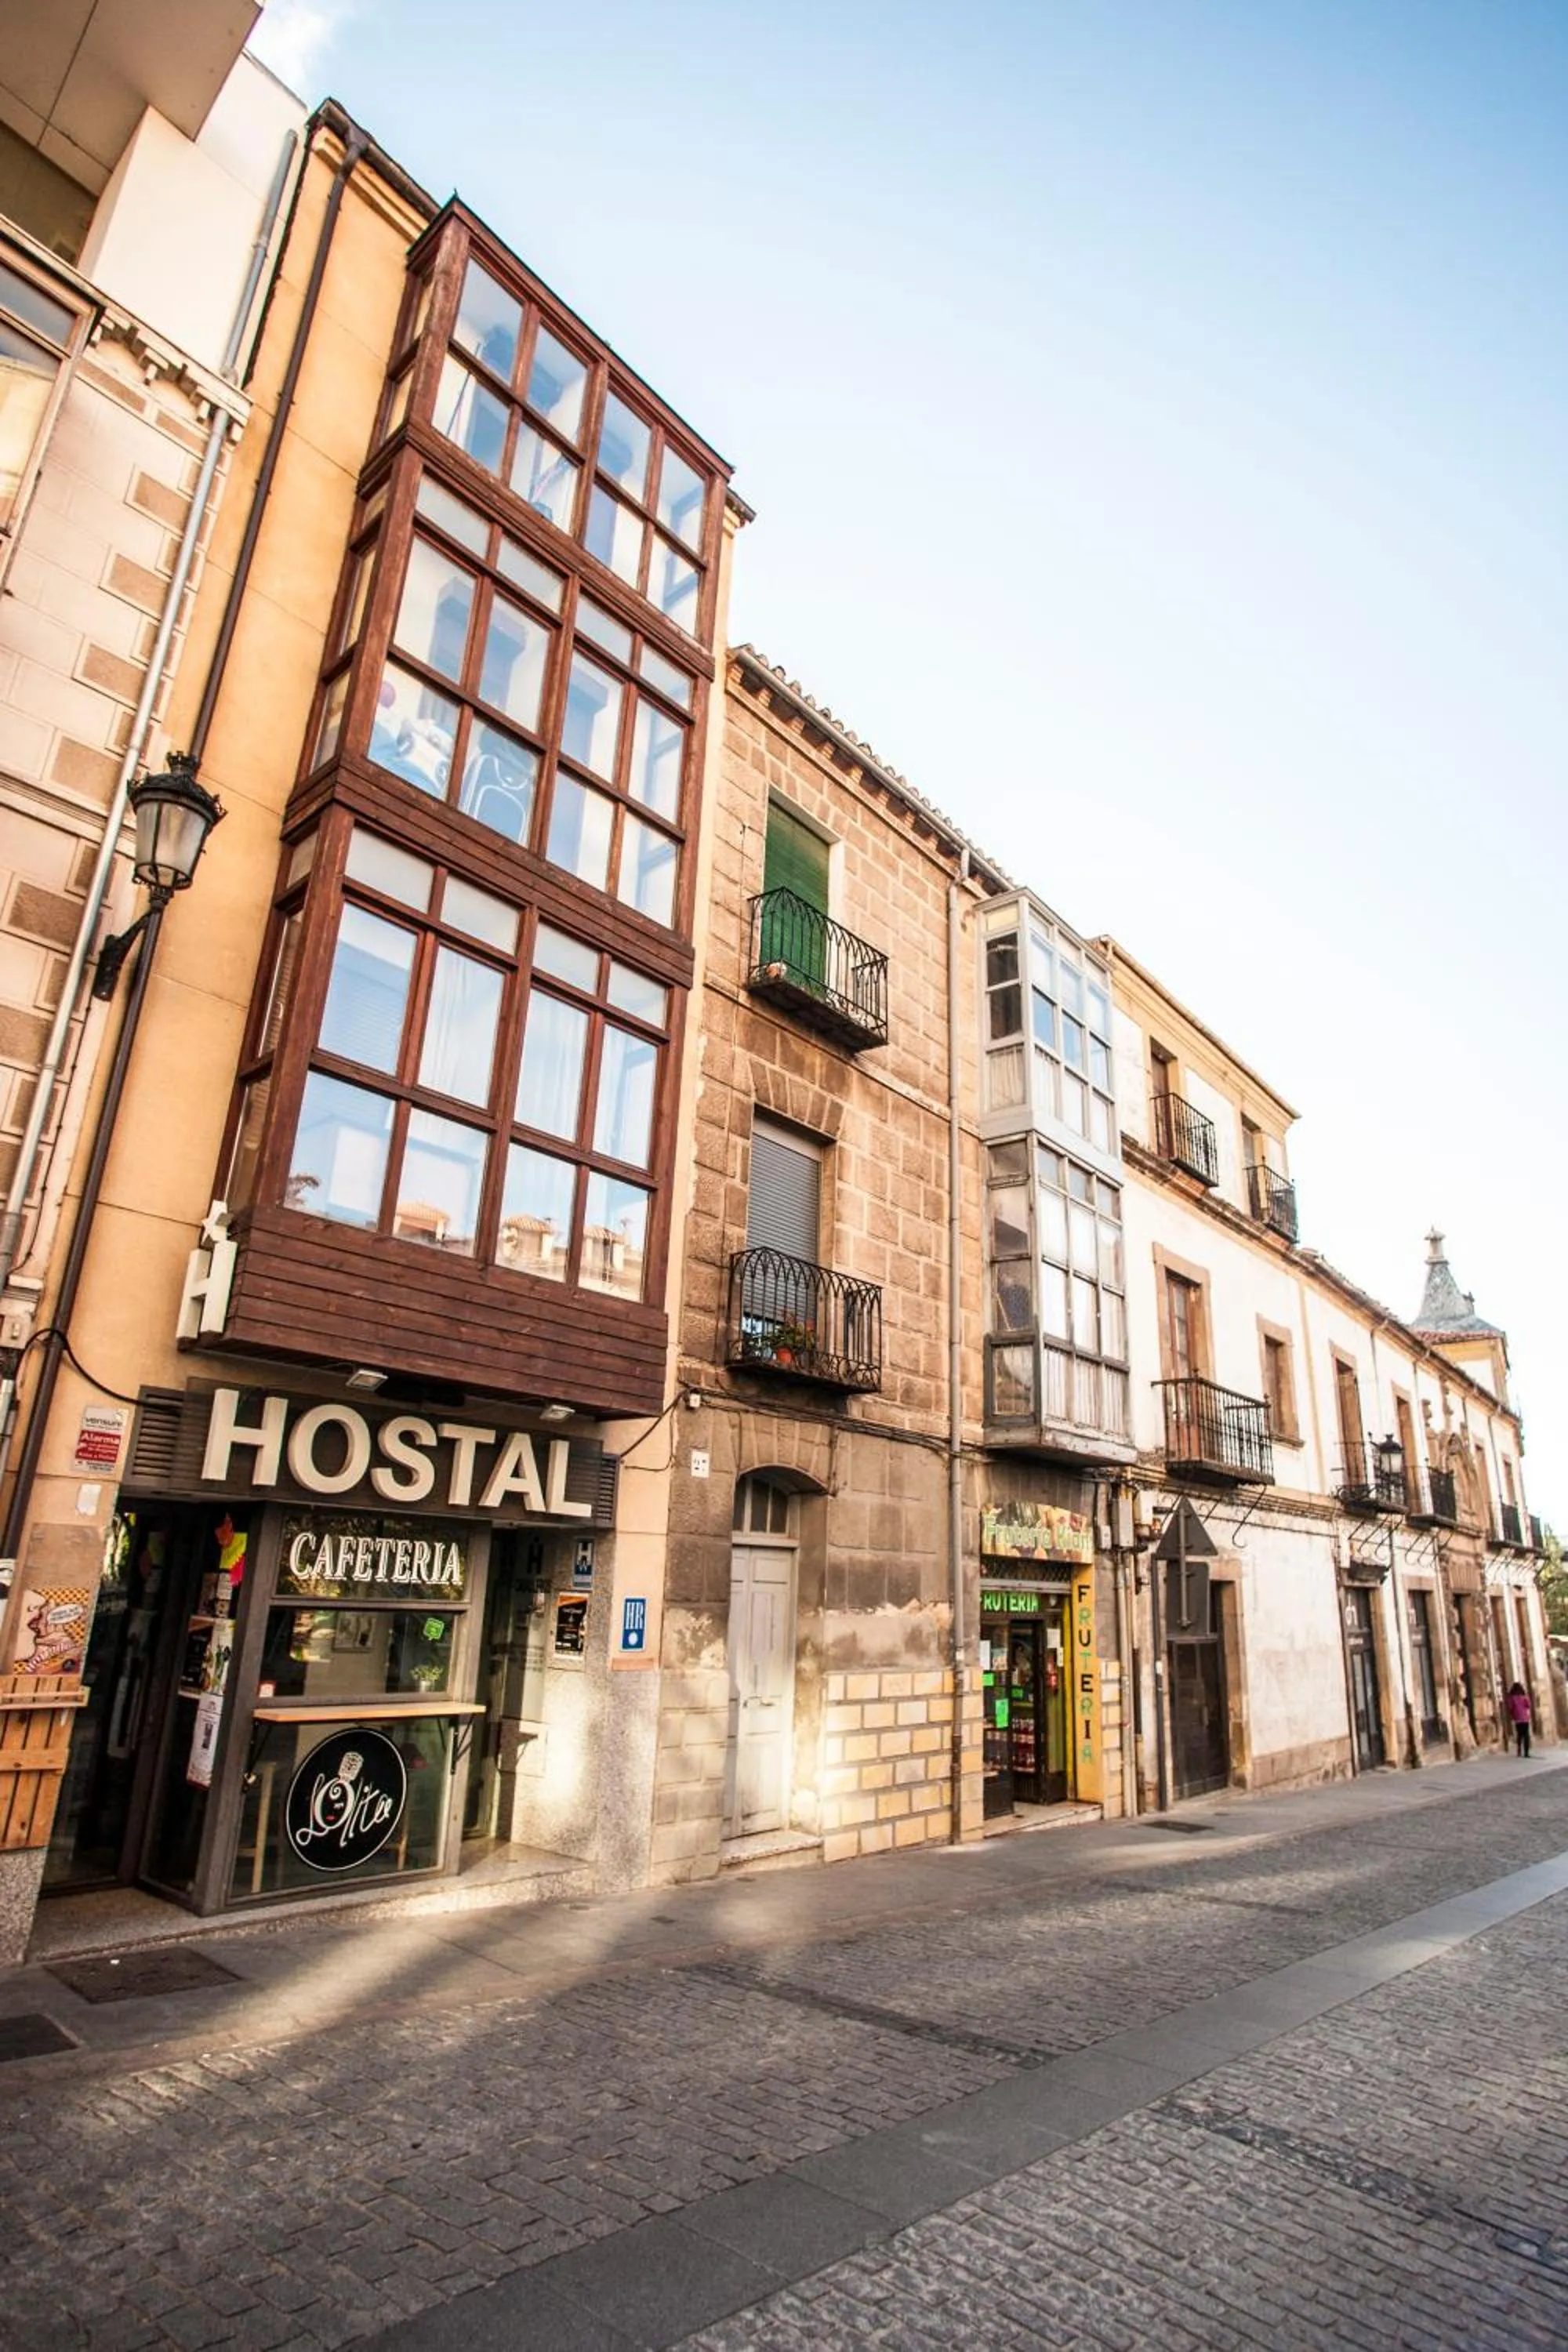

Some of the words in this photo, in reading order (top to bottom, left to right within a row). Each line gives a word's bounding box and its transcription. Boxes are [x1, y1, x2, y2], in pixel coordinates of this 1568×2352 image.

[201, 1388, 592, 1517] HOSTAL
[289, 1531, 463, 1585] CAFETERIA
[1077, 1584, 1094, 1763] FRUTERIA
